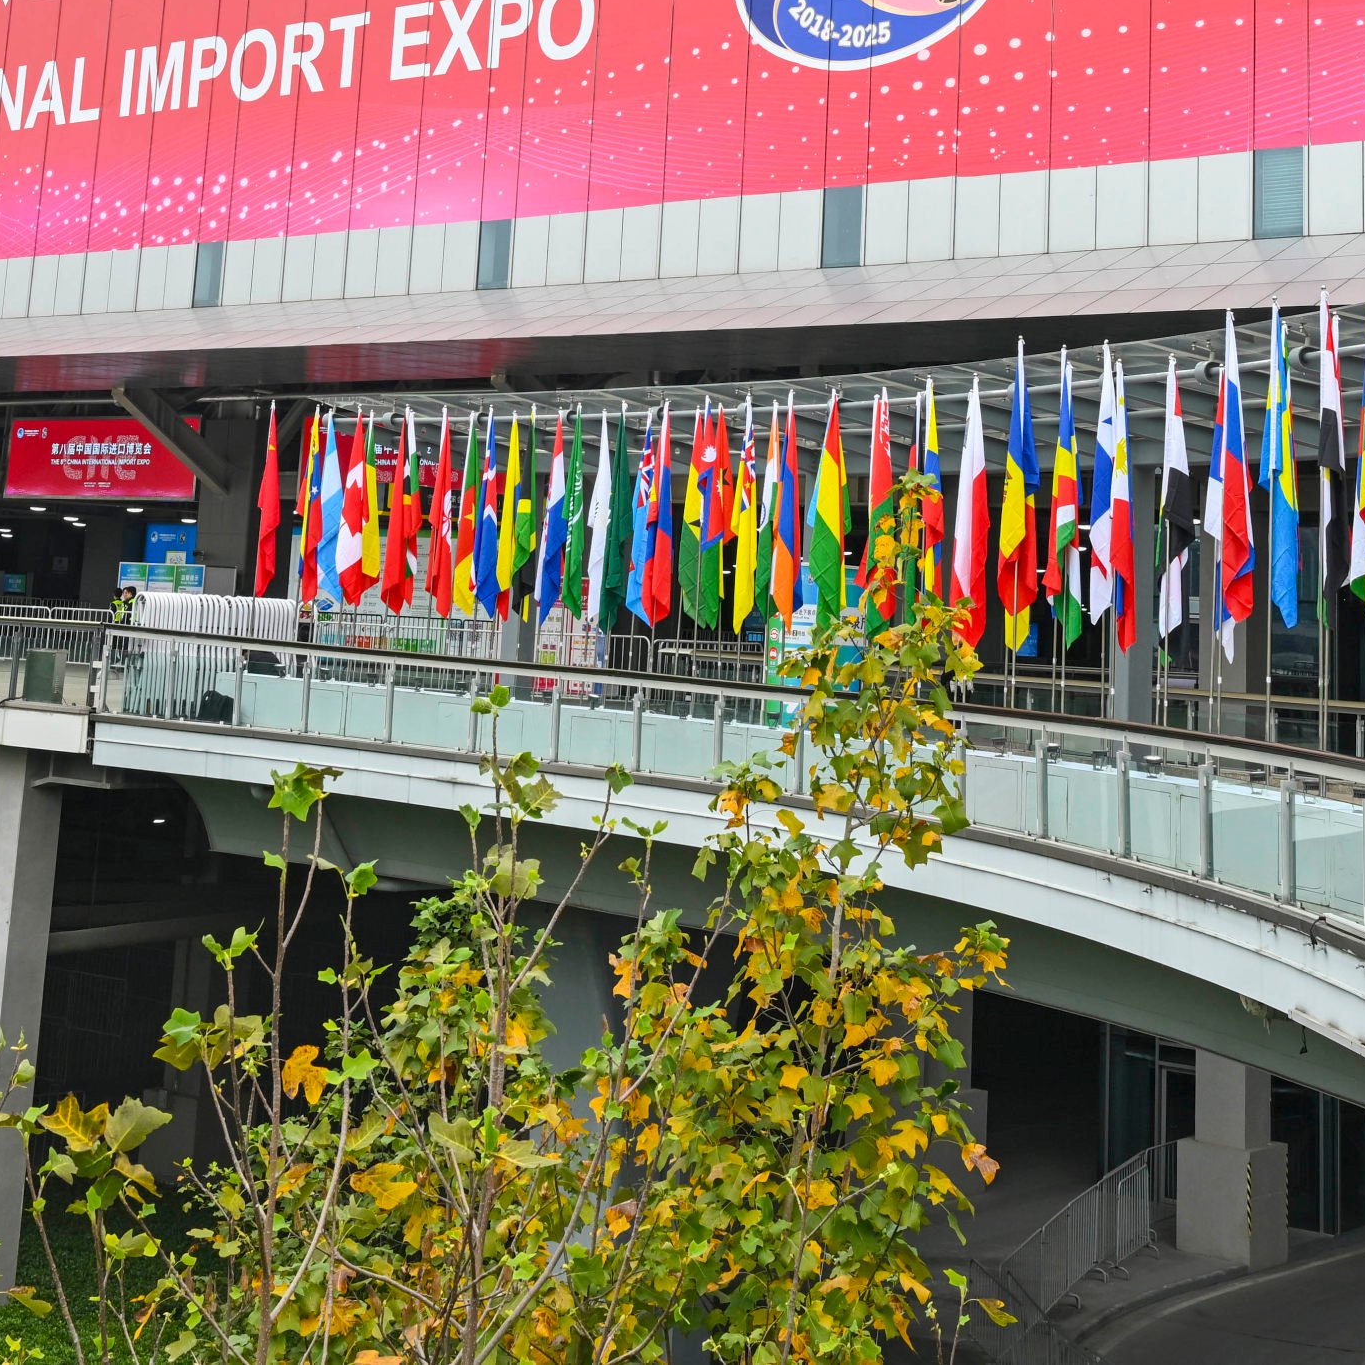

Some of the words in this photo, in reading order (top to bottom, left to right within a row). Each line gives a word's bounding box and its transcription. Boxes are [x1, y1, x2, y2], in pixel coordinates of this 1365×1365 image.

[119, 11, 370, 117] IMPORT
[51, 442, 152, 456] 第八届中国国际进口博览会
